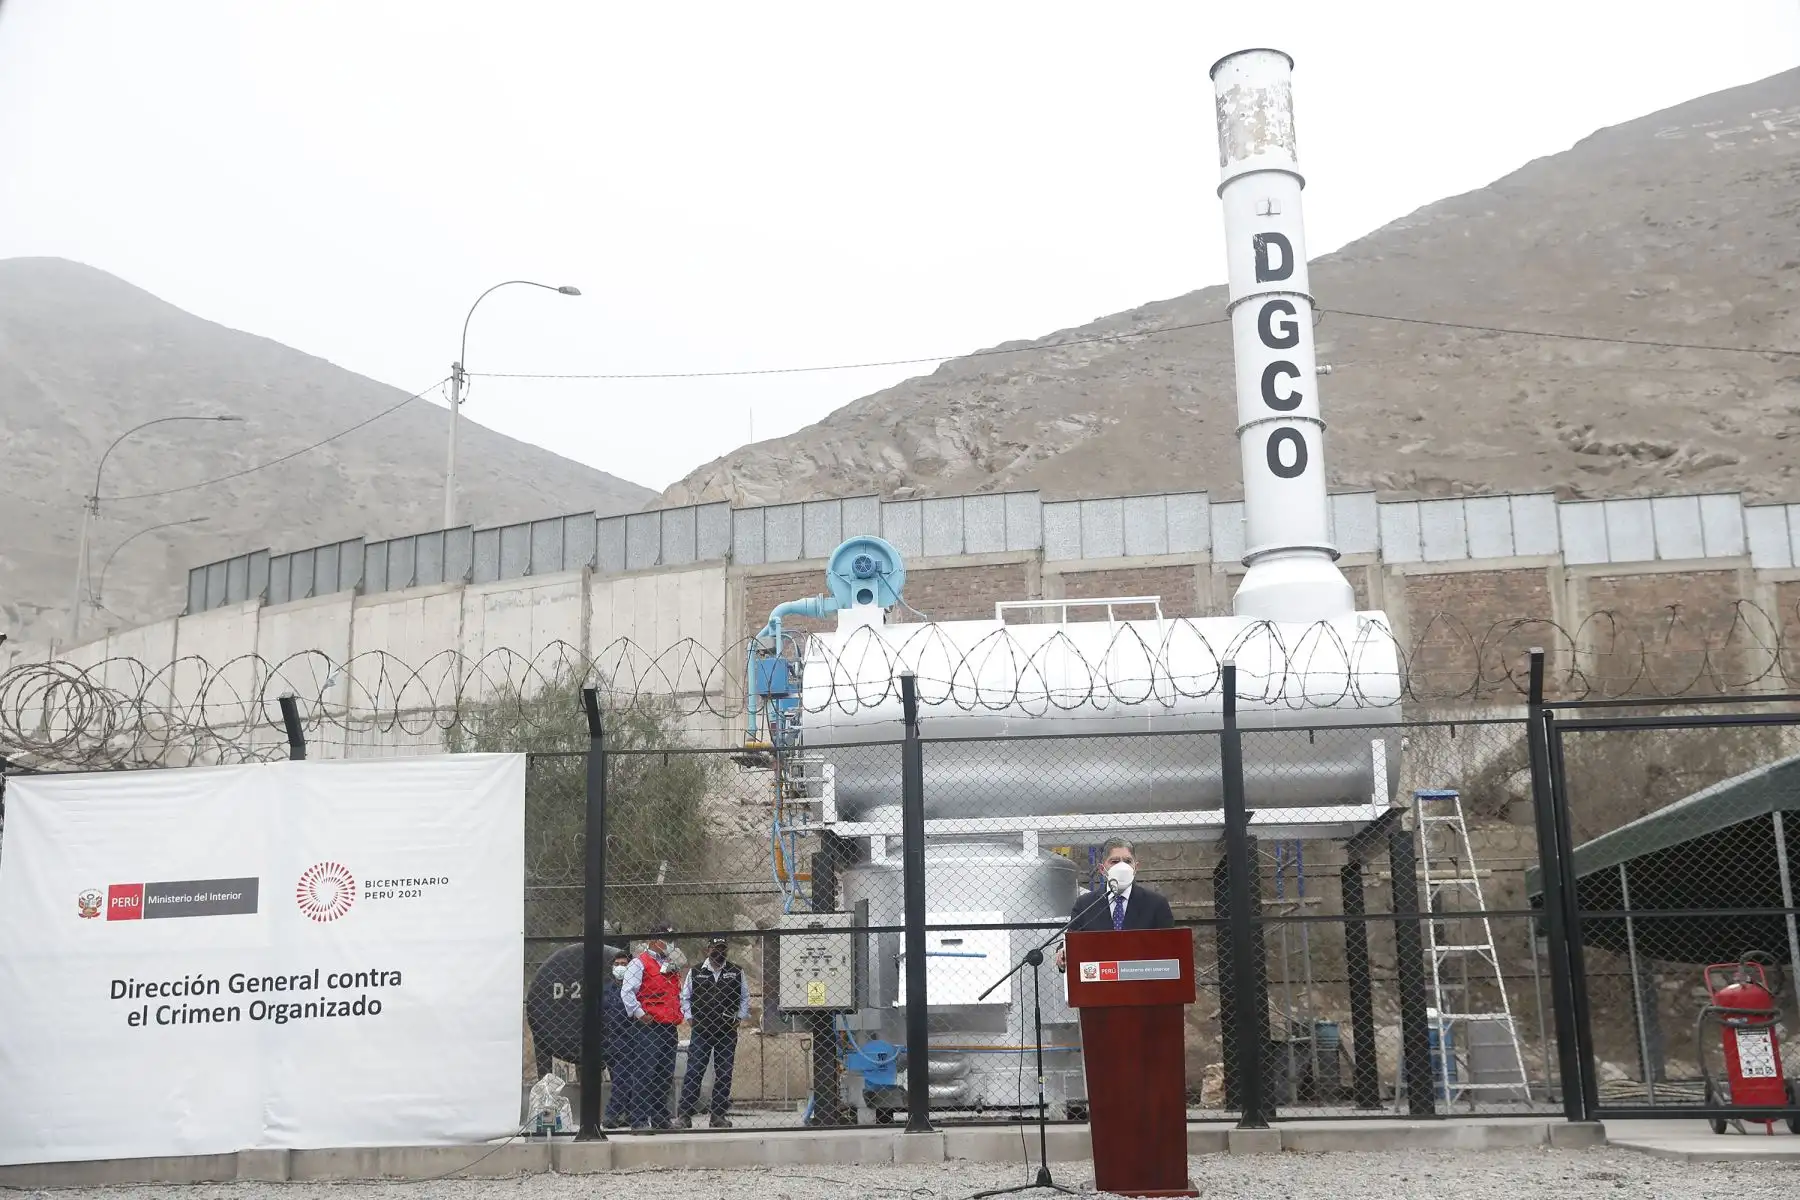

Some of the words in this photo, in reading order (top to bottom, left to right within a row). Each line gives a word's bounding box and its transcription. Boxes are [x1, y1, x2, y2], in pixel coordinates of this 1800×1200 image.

[1252, 232, 1308, 479] DGCO
[365, 877, 449, 888] BICENTENARIO
[111, 894, 139, 908] PERÚ
[148, 893, 192, 905] Ministerio
[194, 891, 208, 902] del
[209, 891, 242, 901] Interior
[364, 889, 394, 900] PERÚ
[398, 890, 422, 898] 2021
[110, 974, 220, 1000] Dirección
[228, 969, 320, 994] General
[327, 968, 402, 989] contra
[127, 1005, 148, 1027] el
[155, 1003, 241, 1025] Crimen
[249, 994, 382, 1024] Organizado
